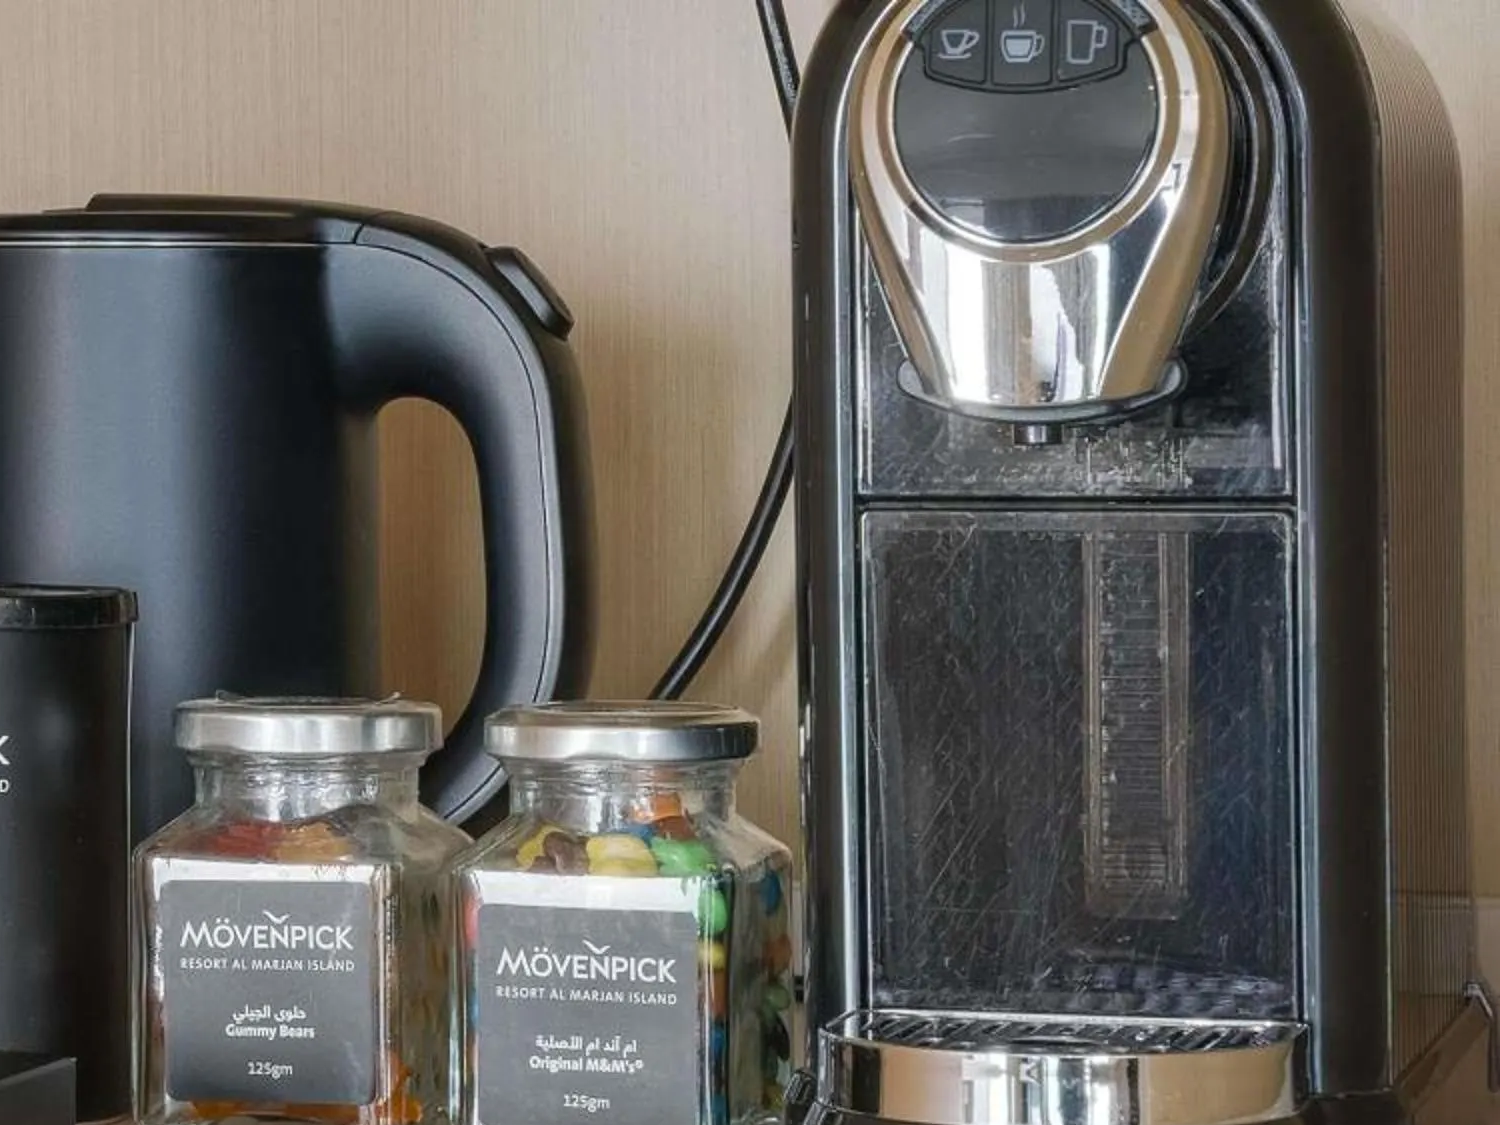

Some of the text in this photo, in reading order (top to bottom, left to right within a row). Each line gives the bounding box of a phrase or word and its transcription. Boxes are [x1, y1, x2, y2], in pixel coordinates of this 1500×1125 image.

[180, 917, 354, 950] MÖVENPICK
[180, 958, 355, 972] RESORT AL MARJAN ISLAND
[496, 946, 677, 984] MÖVENPICK
[496, 986, 677, 1005] RESORT AL MARJAN ISLAND
[225, 1024, 316, 1041] Gummy Bears
[248, 1062, 293, 1079] 125gm
[529, 1056, 584, 1073] Original
[564, 1094, 610, 1113] 125gm
